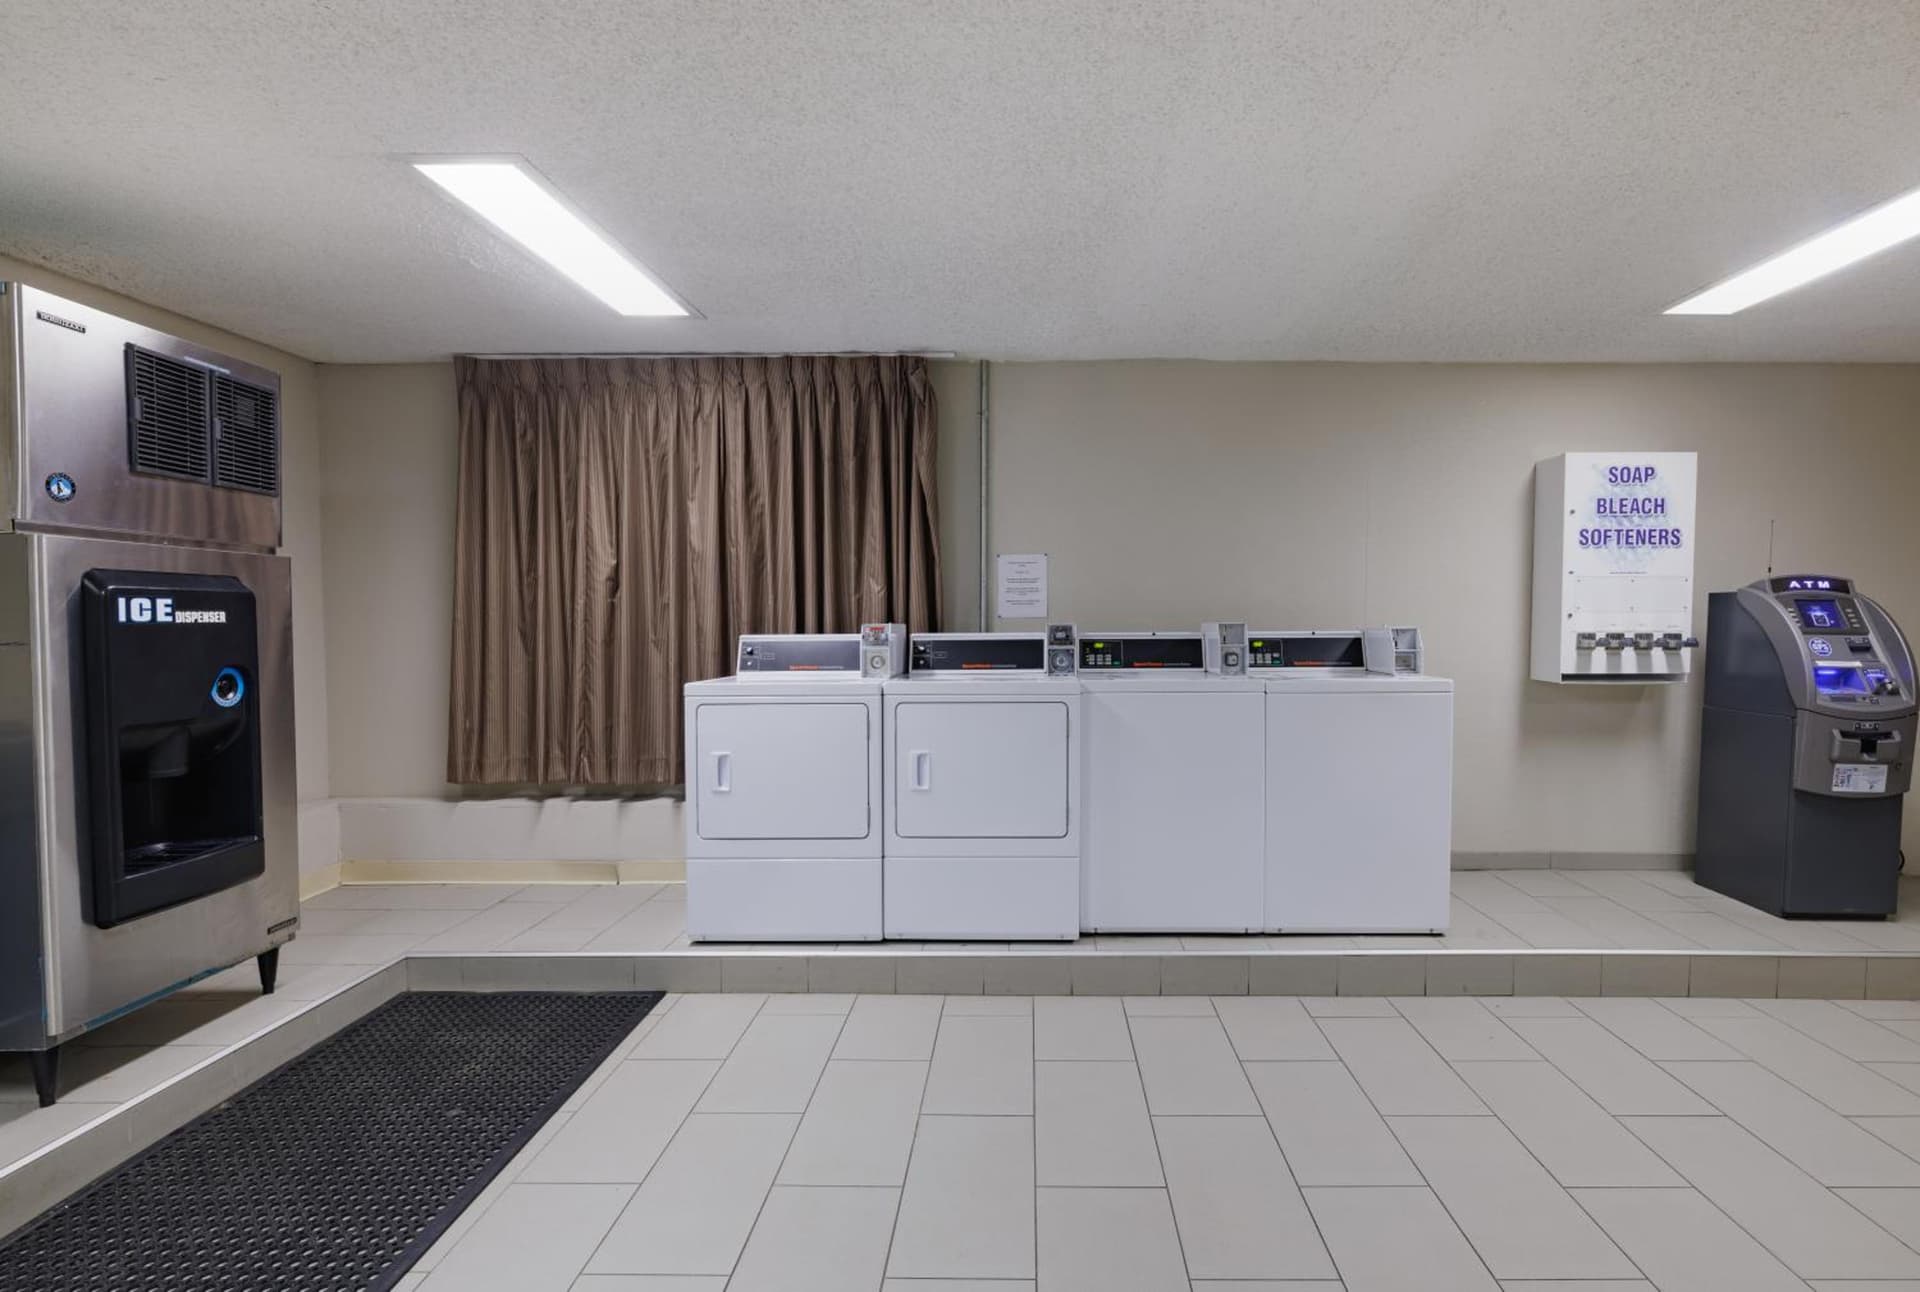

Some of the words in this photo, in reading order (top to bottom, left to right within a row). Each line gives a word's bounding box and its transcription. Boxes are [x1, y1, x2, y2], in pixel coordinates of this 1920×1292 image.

[1608, 466, 1656, 484] SOAP
[1596, 497, 1666, 515] BLEACH
[1579, 528, 1682, 546] SOFTENERS
[1789, 580, 1831, 589] ATM
[117, 597, 173, 623] ICE
[174, 610, 227, 624] DISPENSER
